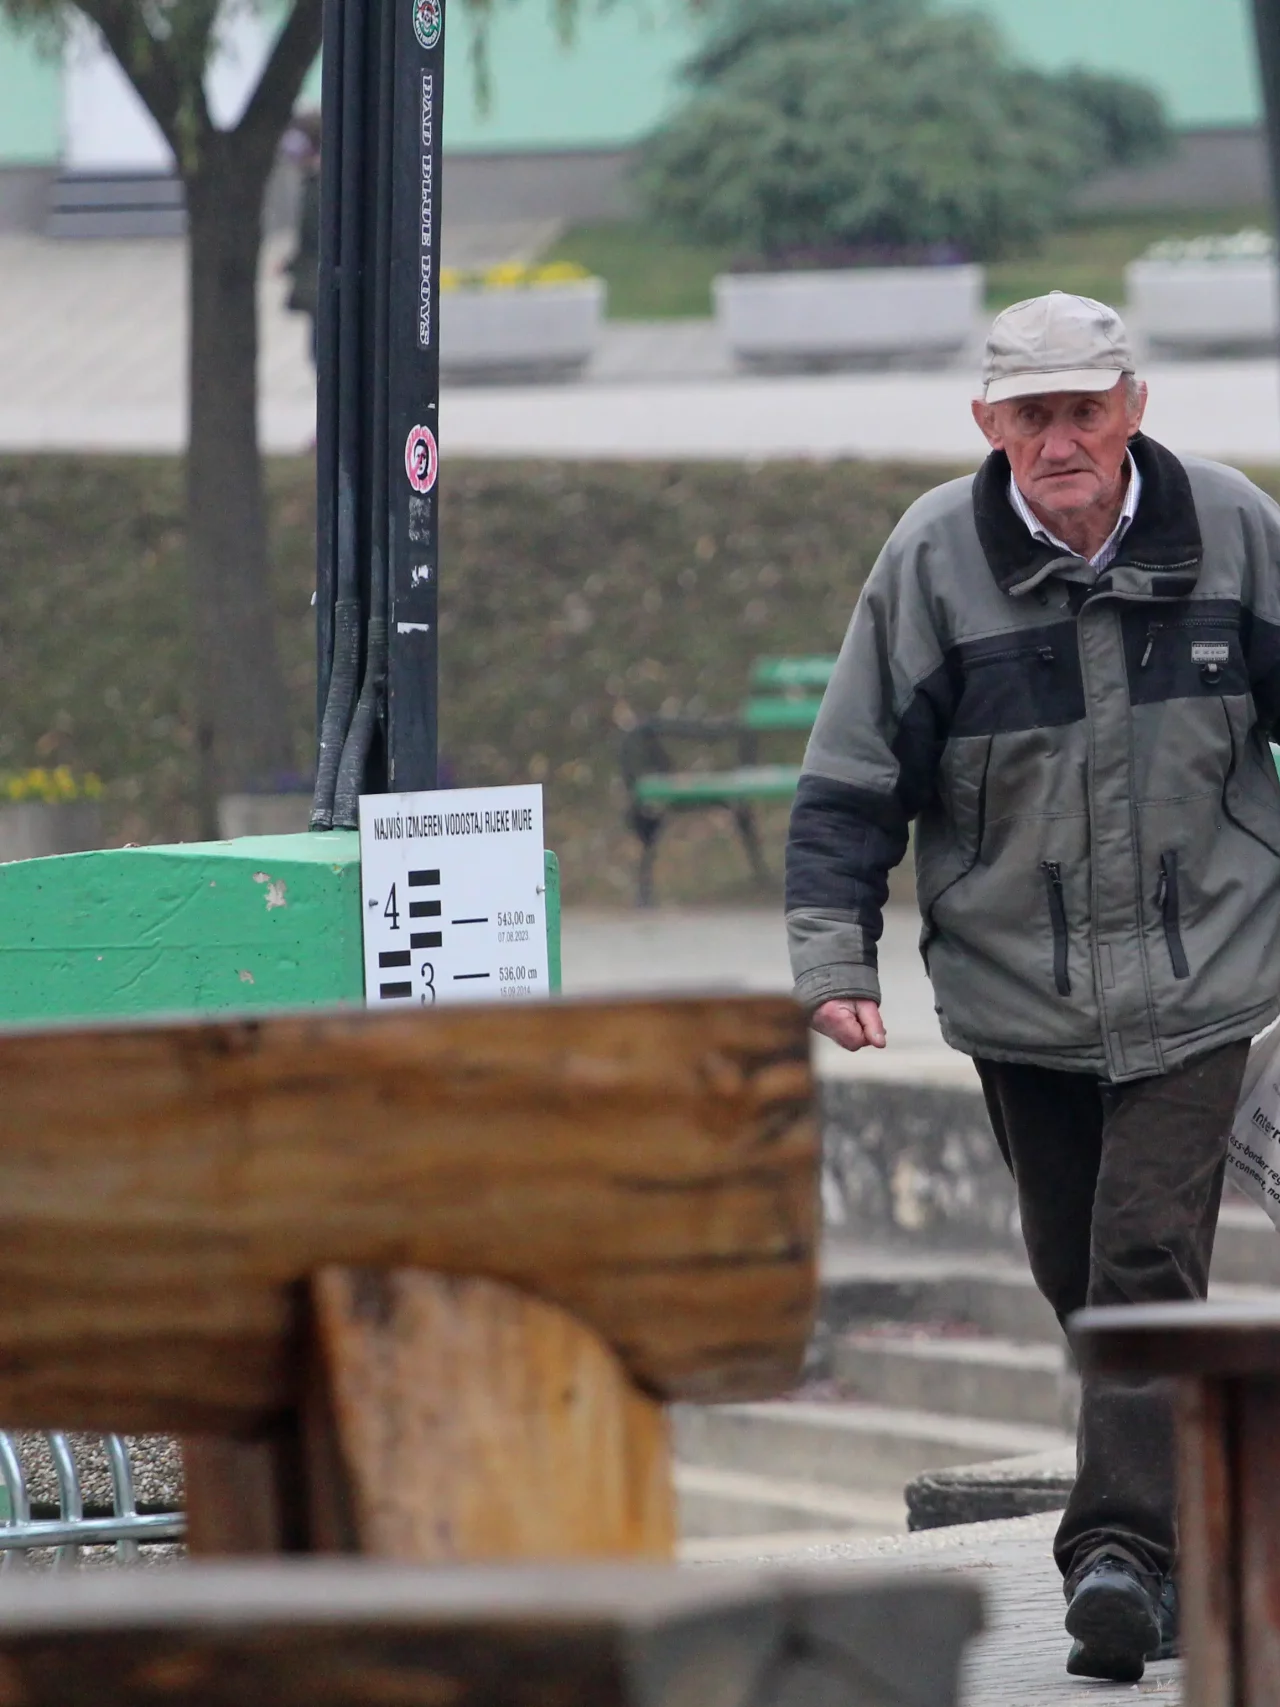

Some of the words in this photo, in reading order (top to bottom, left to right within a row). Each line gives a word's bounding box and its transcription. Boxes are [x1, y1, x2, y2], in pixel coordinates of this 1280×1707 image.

[423, 74, 432, 147] BAD
[422, 154, 432, 247] BLUE
[419, 254, 431, 346] BOYS
[374, 811, 403, 840] NAJVIŠI
[406, 814, 443, 839] IZMJEREN
[445, 812, 483, 836] VODOSTAJ
[485, 810, 510, 833] RIJEKE
[511, 808, 533, 832] MURE
[384, 882, 400, 930] 4
[497, 911, 524, 927] 543,00
[525, 914, 535, 924] cm
[421, 962, 436, 1008] 3
[499, 965, 526, 982] 536,00
[527, 968, 538, 980] cm
[1235, 1160, 1266, 1191] connect,
